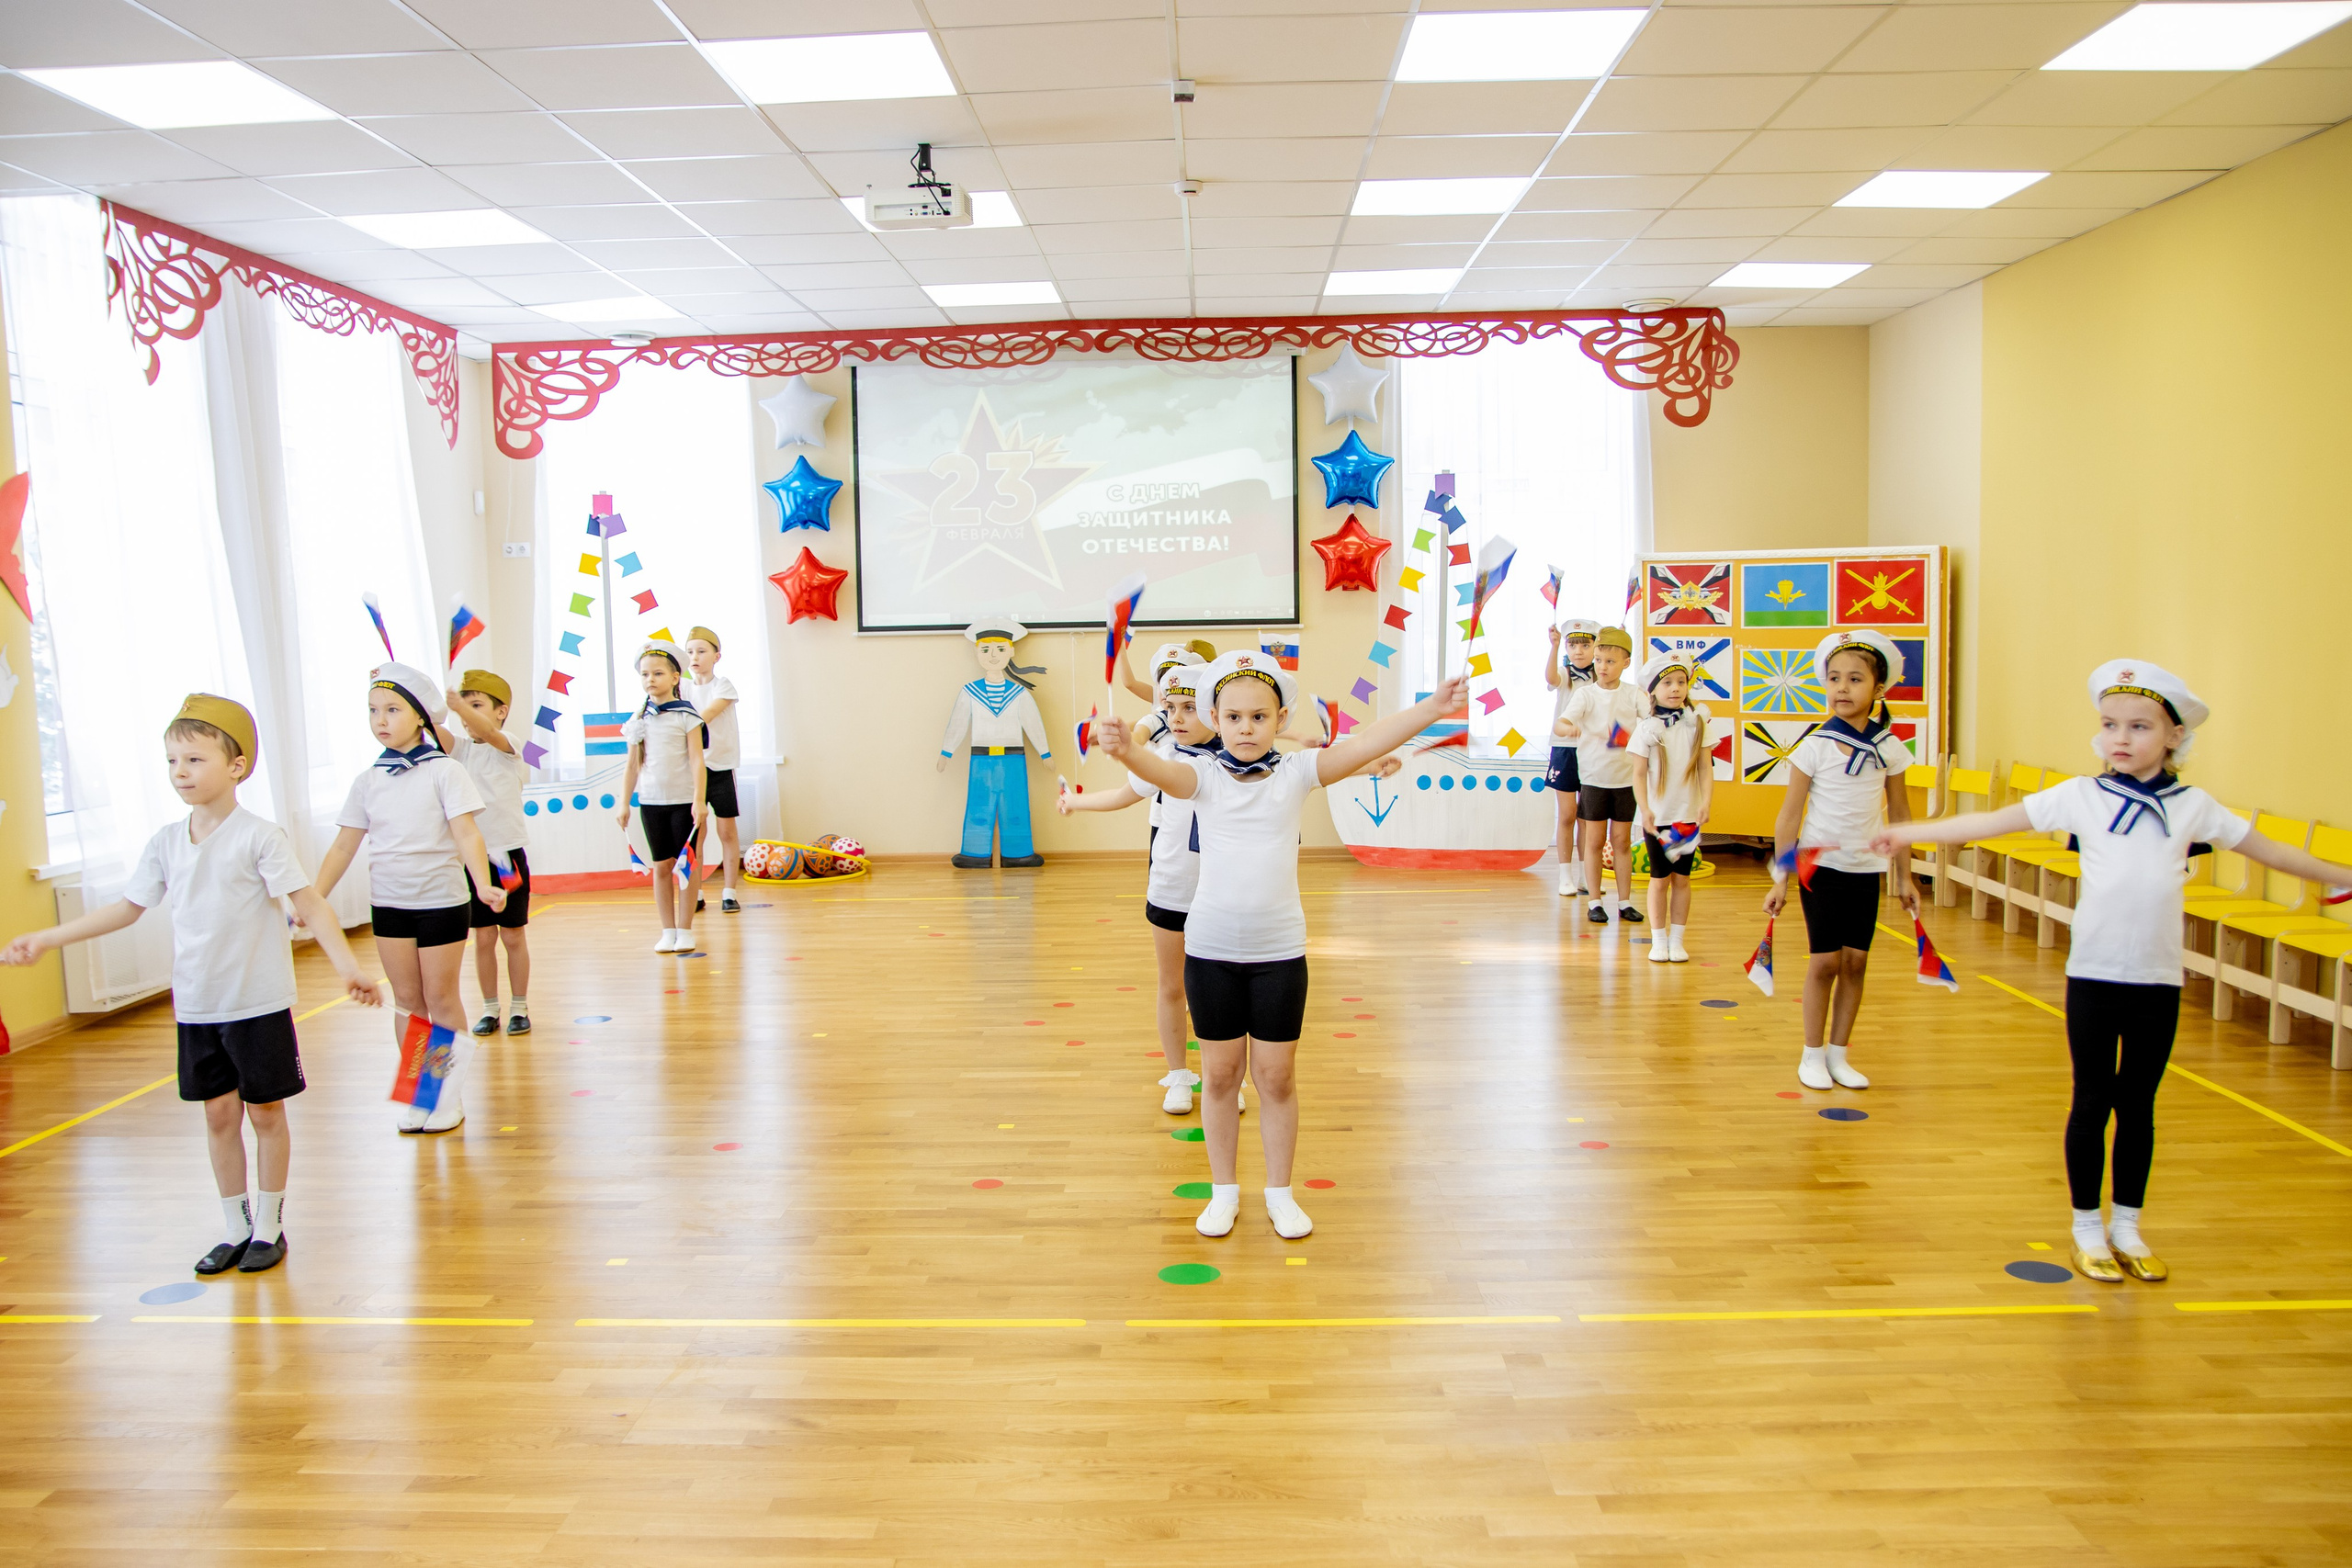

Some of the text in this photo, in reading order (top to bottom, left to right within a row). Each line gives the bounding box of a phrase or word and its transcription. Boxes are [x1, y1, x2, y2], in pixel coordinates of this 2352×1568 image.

[929, 450, 1036, 526] 23
[1106, 482, 1200, 503] С ДНЕМ
[1078, 509, 1232, 529] ЗАЩИТНИКА
[946, 526, 1024, 540] ФЕВРАЛЯ
[1081, 536, 1229, 554] ОТЕЧЕСТВА!
[1676, 640, 1706, 649] ВМФ
[1257, 672, 1276, 687] ФЛОТ
[1182, 688, 1196, 696] ФЛО
